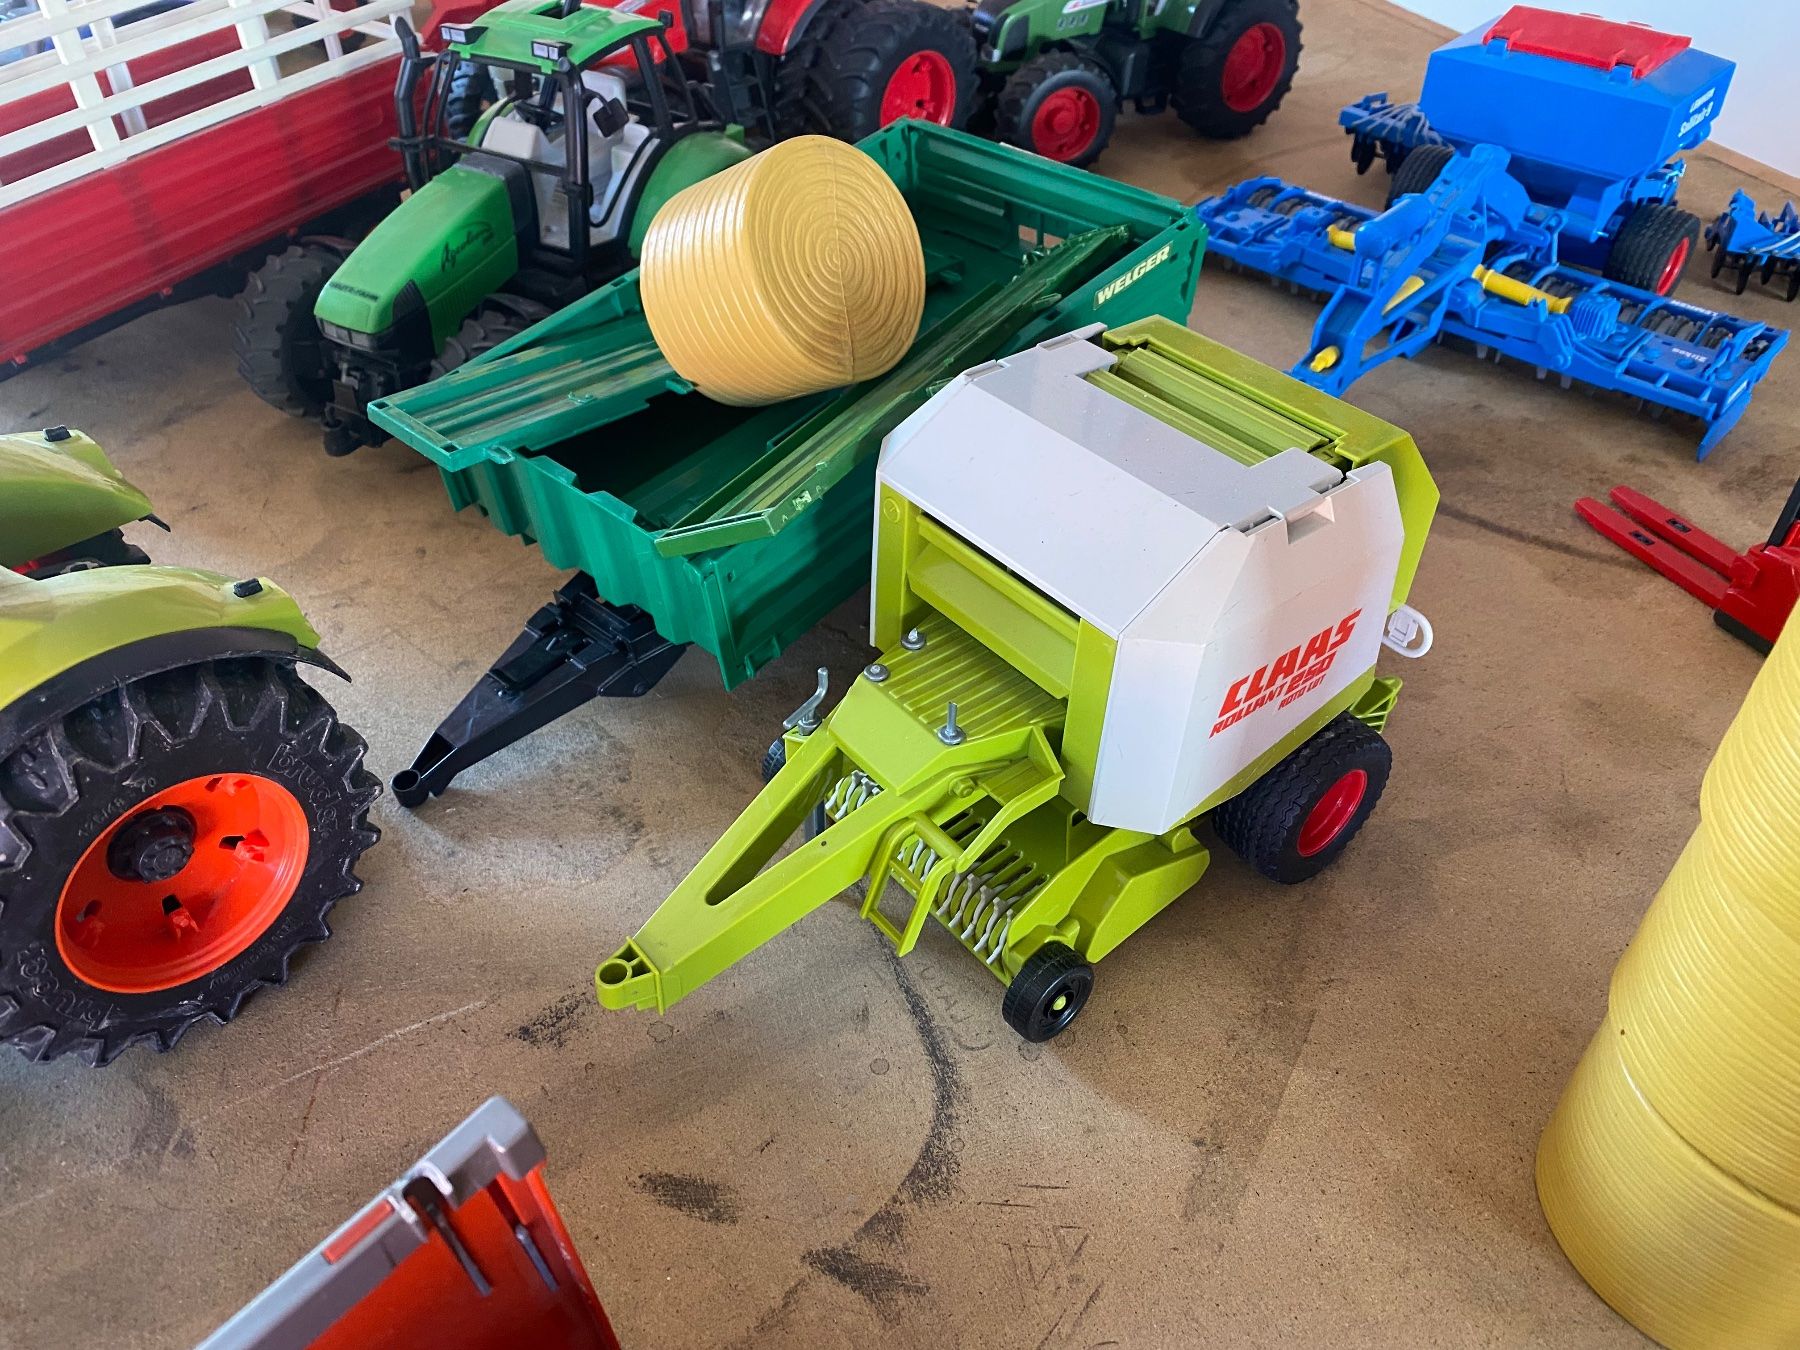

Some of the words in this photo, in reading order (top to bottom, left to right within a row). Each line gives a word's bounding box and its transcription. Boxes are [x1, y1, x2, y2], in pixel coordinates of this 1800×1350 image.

[1098, 246, 1170, 304] WELGER
[1210, 682, 1287, 737] ROLLANT
[1285, 651, 1337, 695] 250
[1218, 608, 1362, 718] CLAAS
[1278, 687, 1308, 711] ROTO
